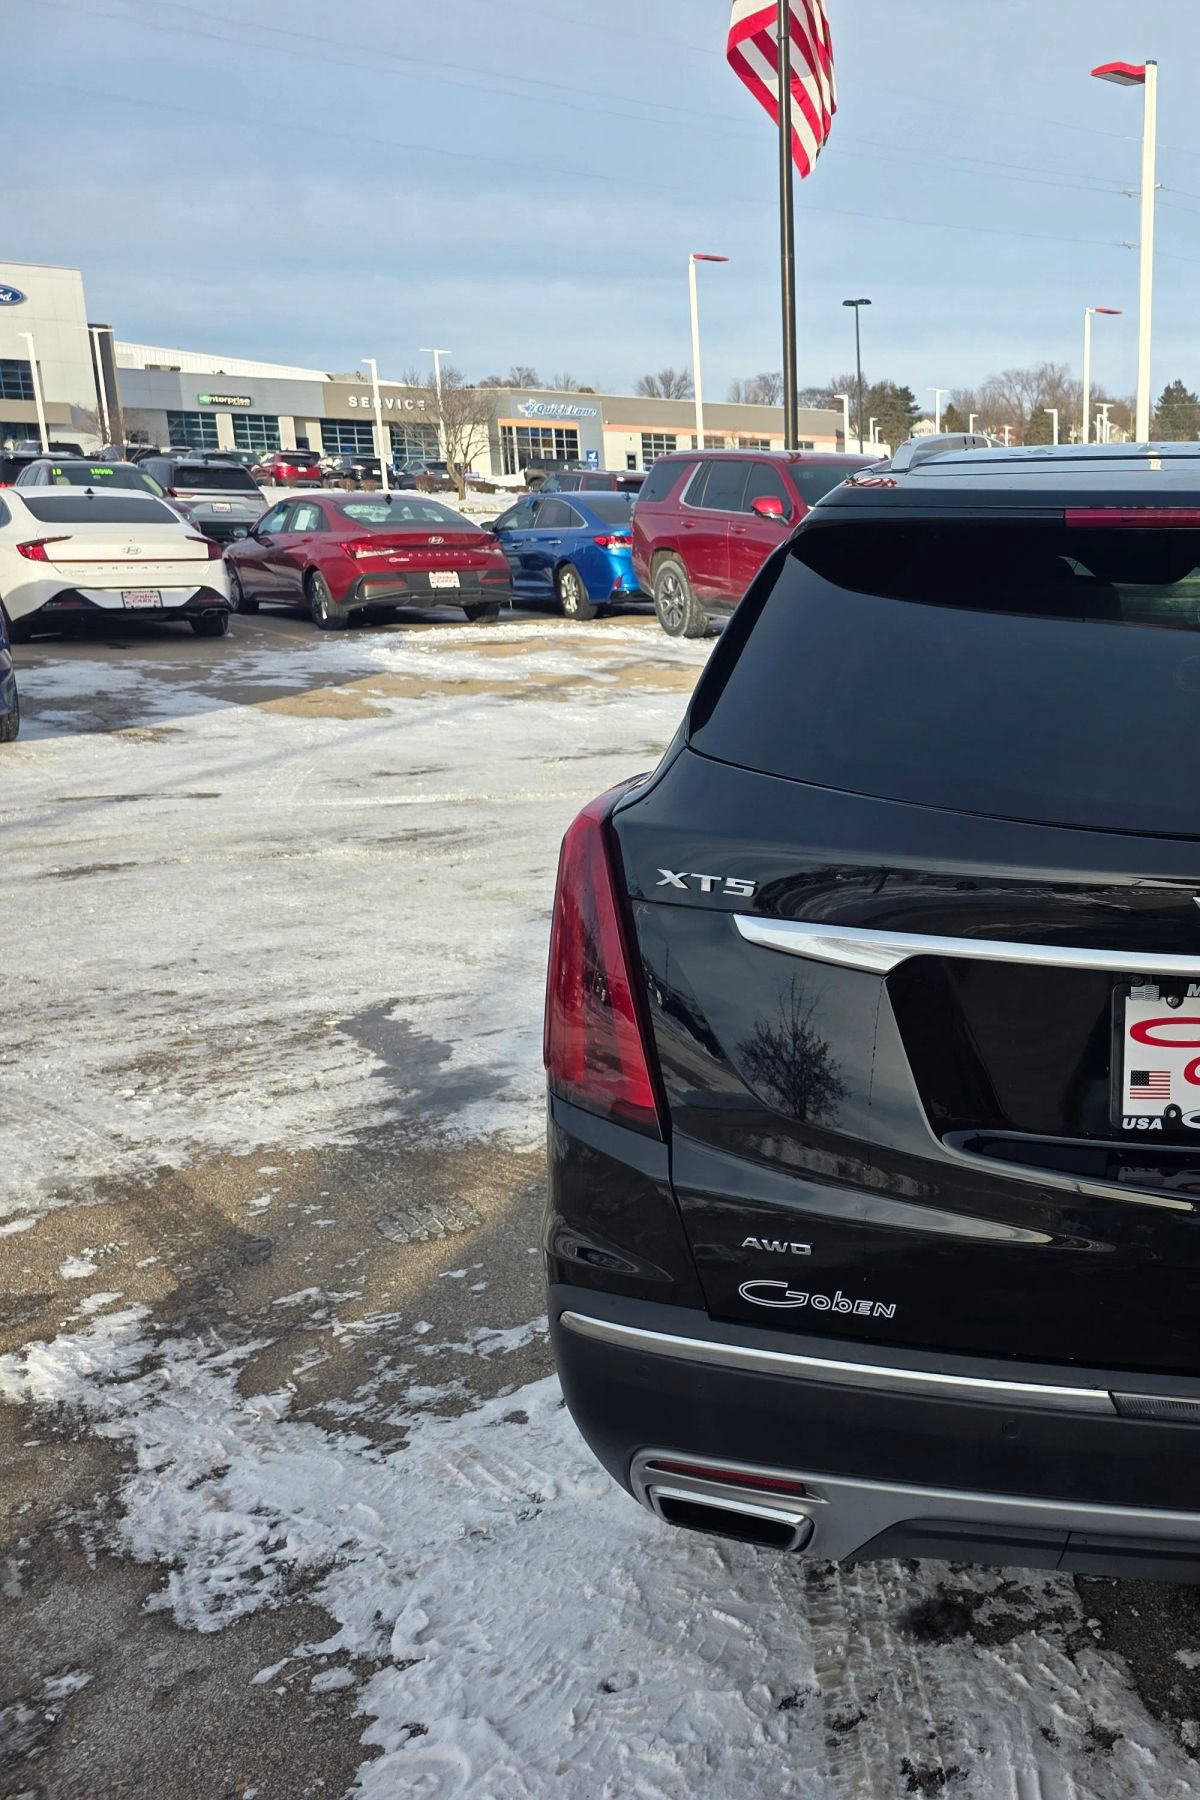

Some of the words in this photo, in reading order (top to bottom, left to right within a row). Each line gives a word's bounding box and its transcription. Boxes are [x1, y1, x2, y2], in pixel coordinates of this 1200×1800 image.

[656, 868, 757, 897] XT5
[1122, 1117, 1163, 1131] USA
[741, 1237, 812, 1256] AWD
